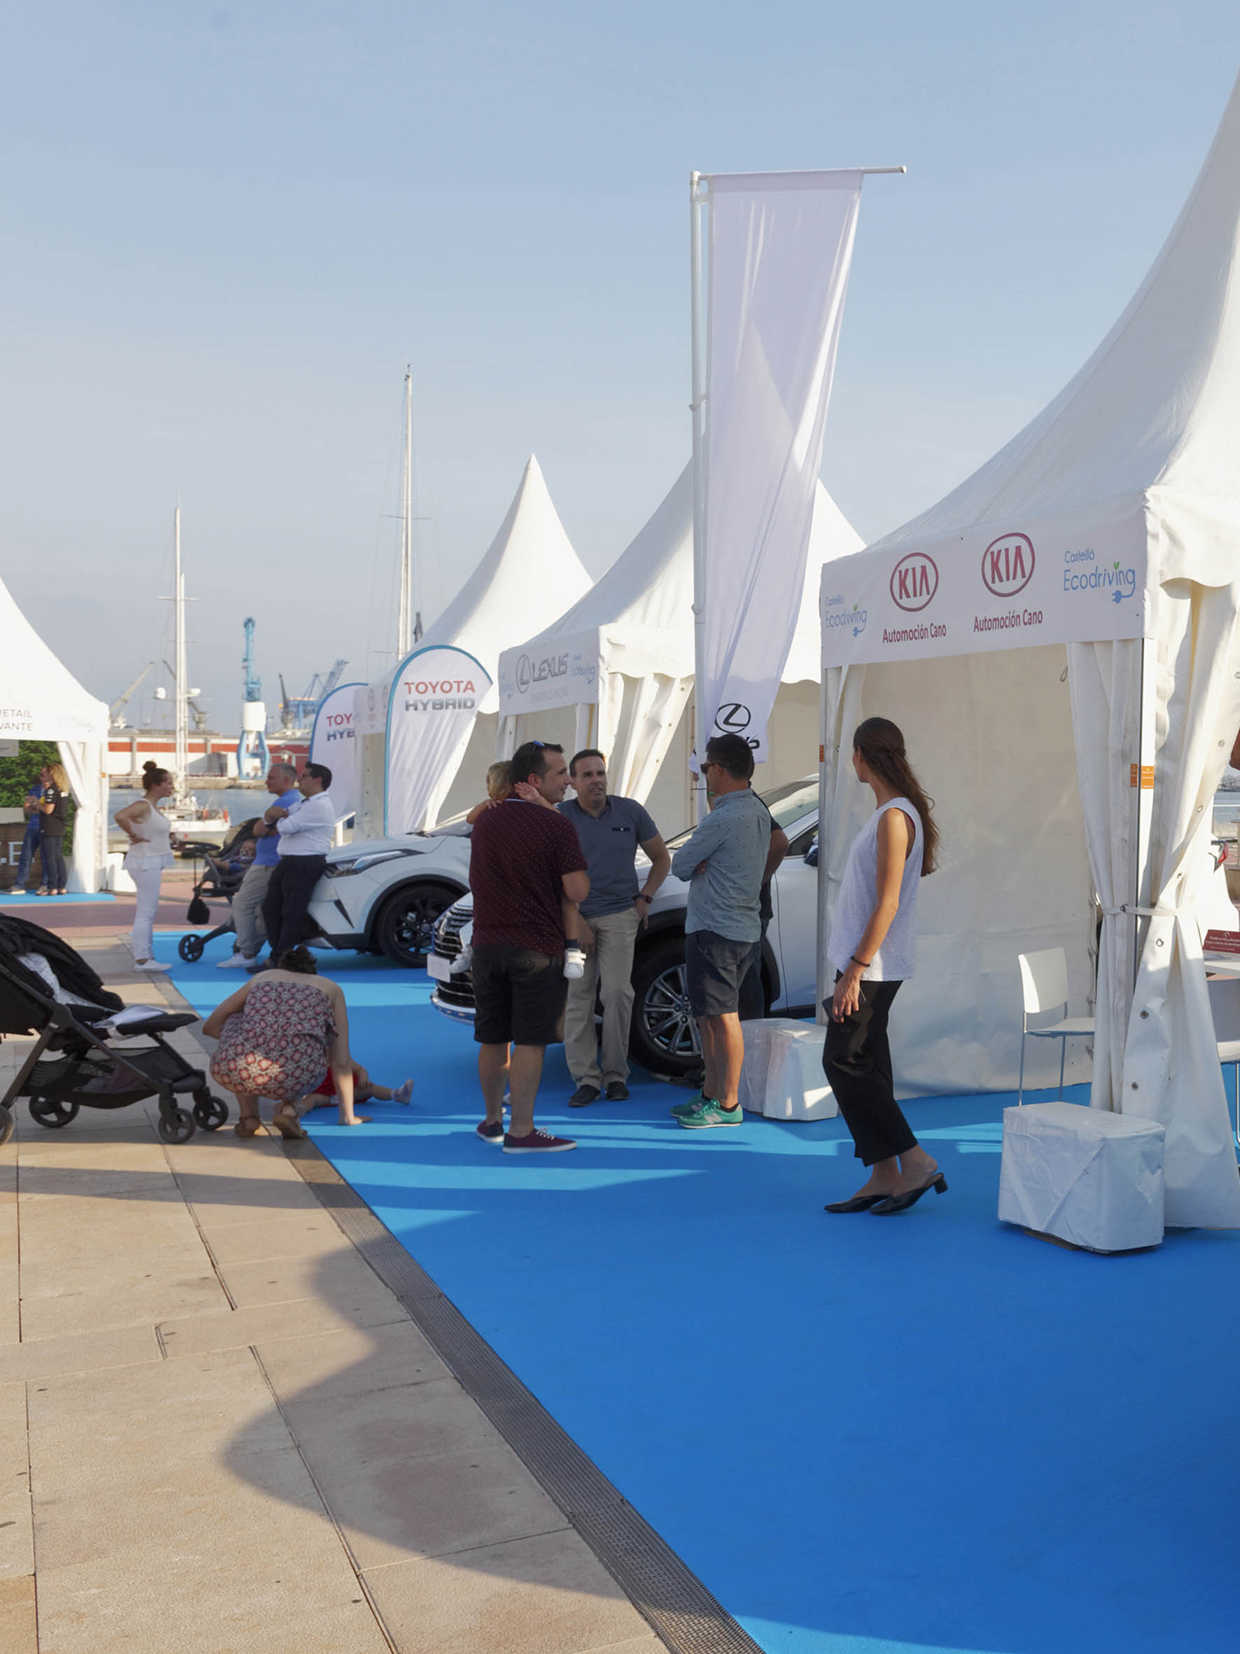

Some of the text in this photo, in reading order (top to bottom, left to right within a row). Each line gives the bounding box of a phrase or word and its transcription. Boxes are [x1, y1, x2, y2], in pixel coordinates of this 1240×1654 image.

[989, 544, 1027, 585] KIA
[898, 564, 931, 600] KIA
[1063, 565, 1136, 592] Ecodriving
[973, 608, 1044, 633] Automoción Cano
[882, 622, 948, 643] Automoción Cano
[532, 652, 569, 683] LEXUS
[404, 680, 476, 696] TOYOTA
[0, 708, 33, 718] ETAIL
[404, 696, 476, 712] HYBRID
[326, 713, 353, 727] TOY
